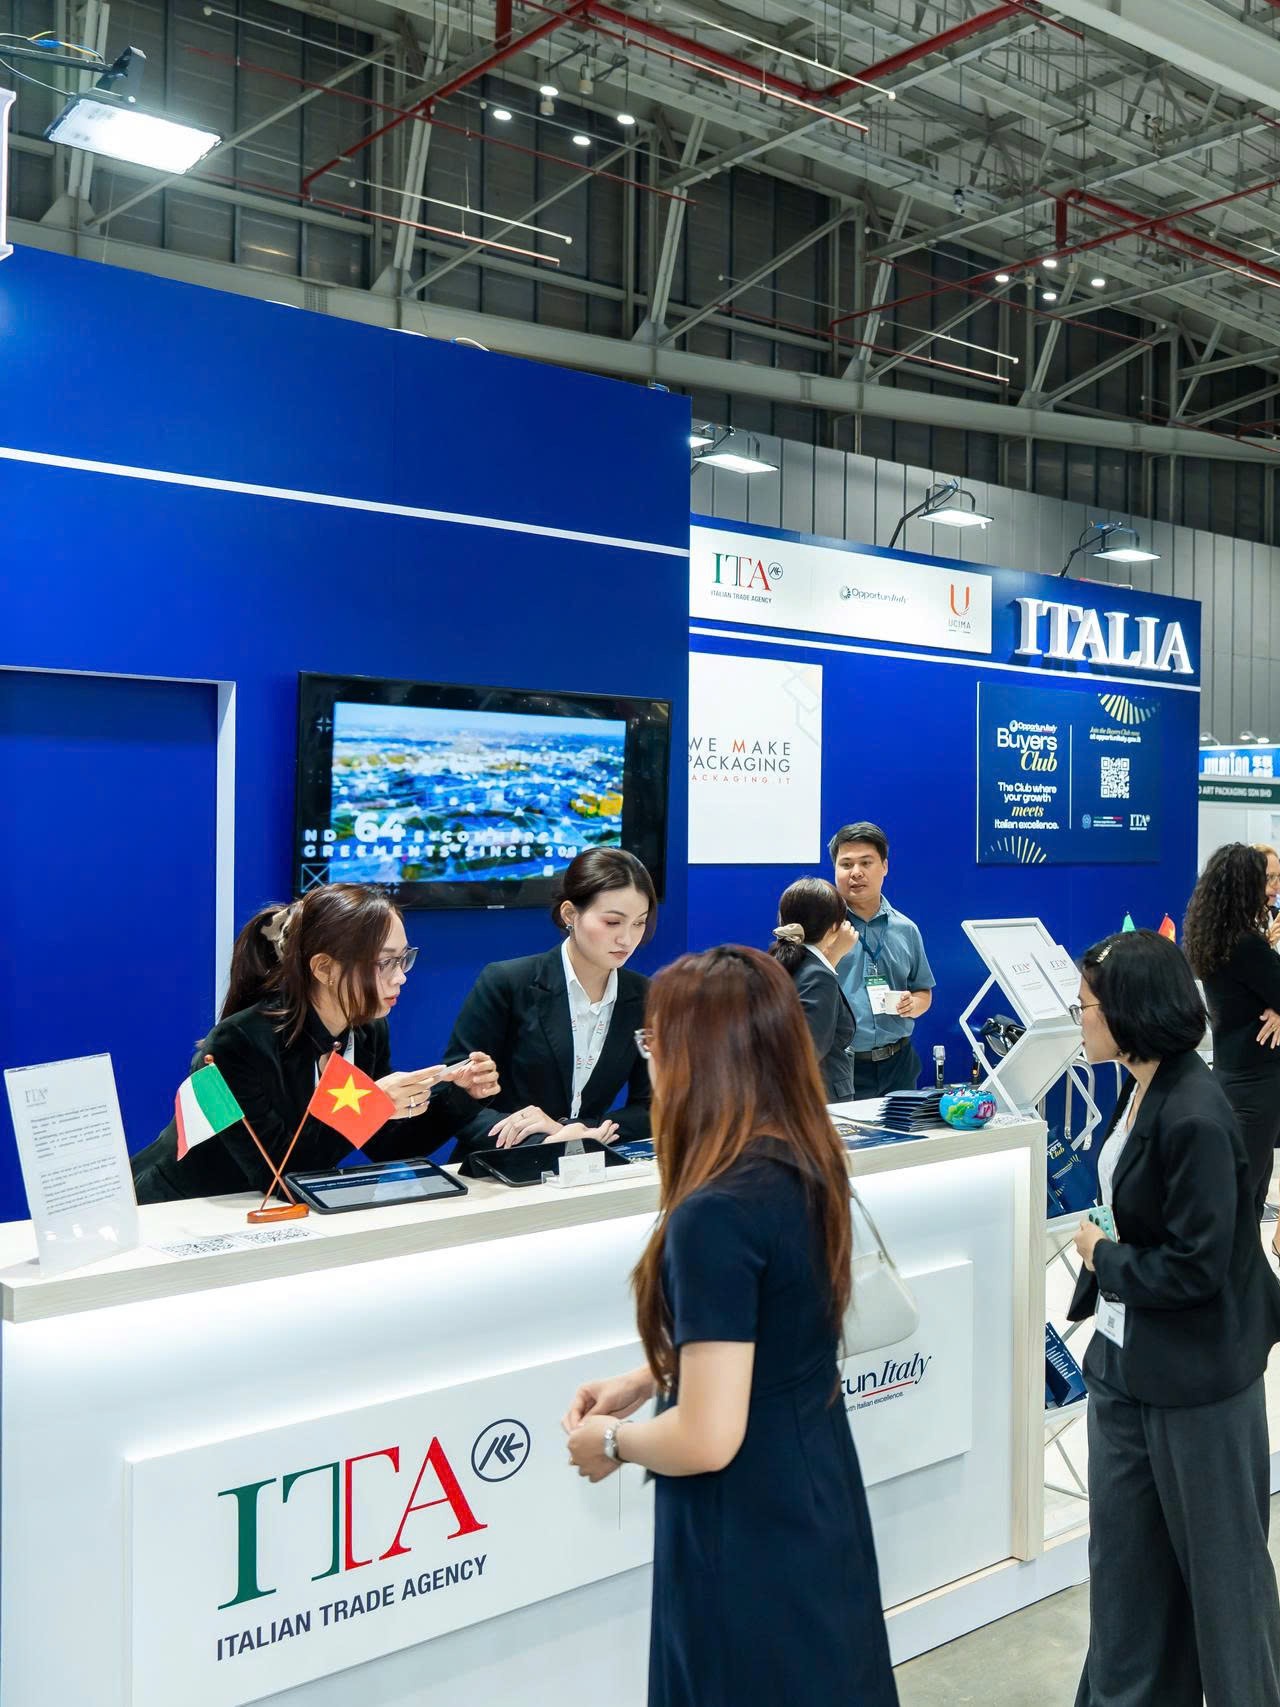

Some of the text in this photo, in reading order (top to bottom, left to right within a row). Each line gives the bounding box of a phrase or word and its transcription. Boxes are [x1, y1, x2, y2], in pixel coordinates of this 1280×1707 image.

[712, 552, 772, 591] ITA
[711, 590, 772, 604] ITALIAN TRADE AGENCY
[1015, 597, 1194, 674] ITALIA
[689, 737, 791, 756] WE MAKE
[997, 728, 1057, 753] Buyers
[1020, 750, 1057, 772] Club
[998, 782, 1057, 794] The Club where
[1004, 794, 1051, 803] your growth
[1011, 806, 1044, 817] meets
[353, 812, 406, 843] 64
[994, 819, 1018, 829] Italian
[465, 846, 531, 858] SINCE
[857, 1400, 873, 1410] Italian
[217, 1436, 488, 1611] ITA
[217, 1554, 488, 1661] ITALIAN TRADE AGENCY
